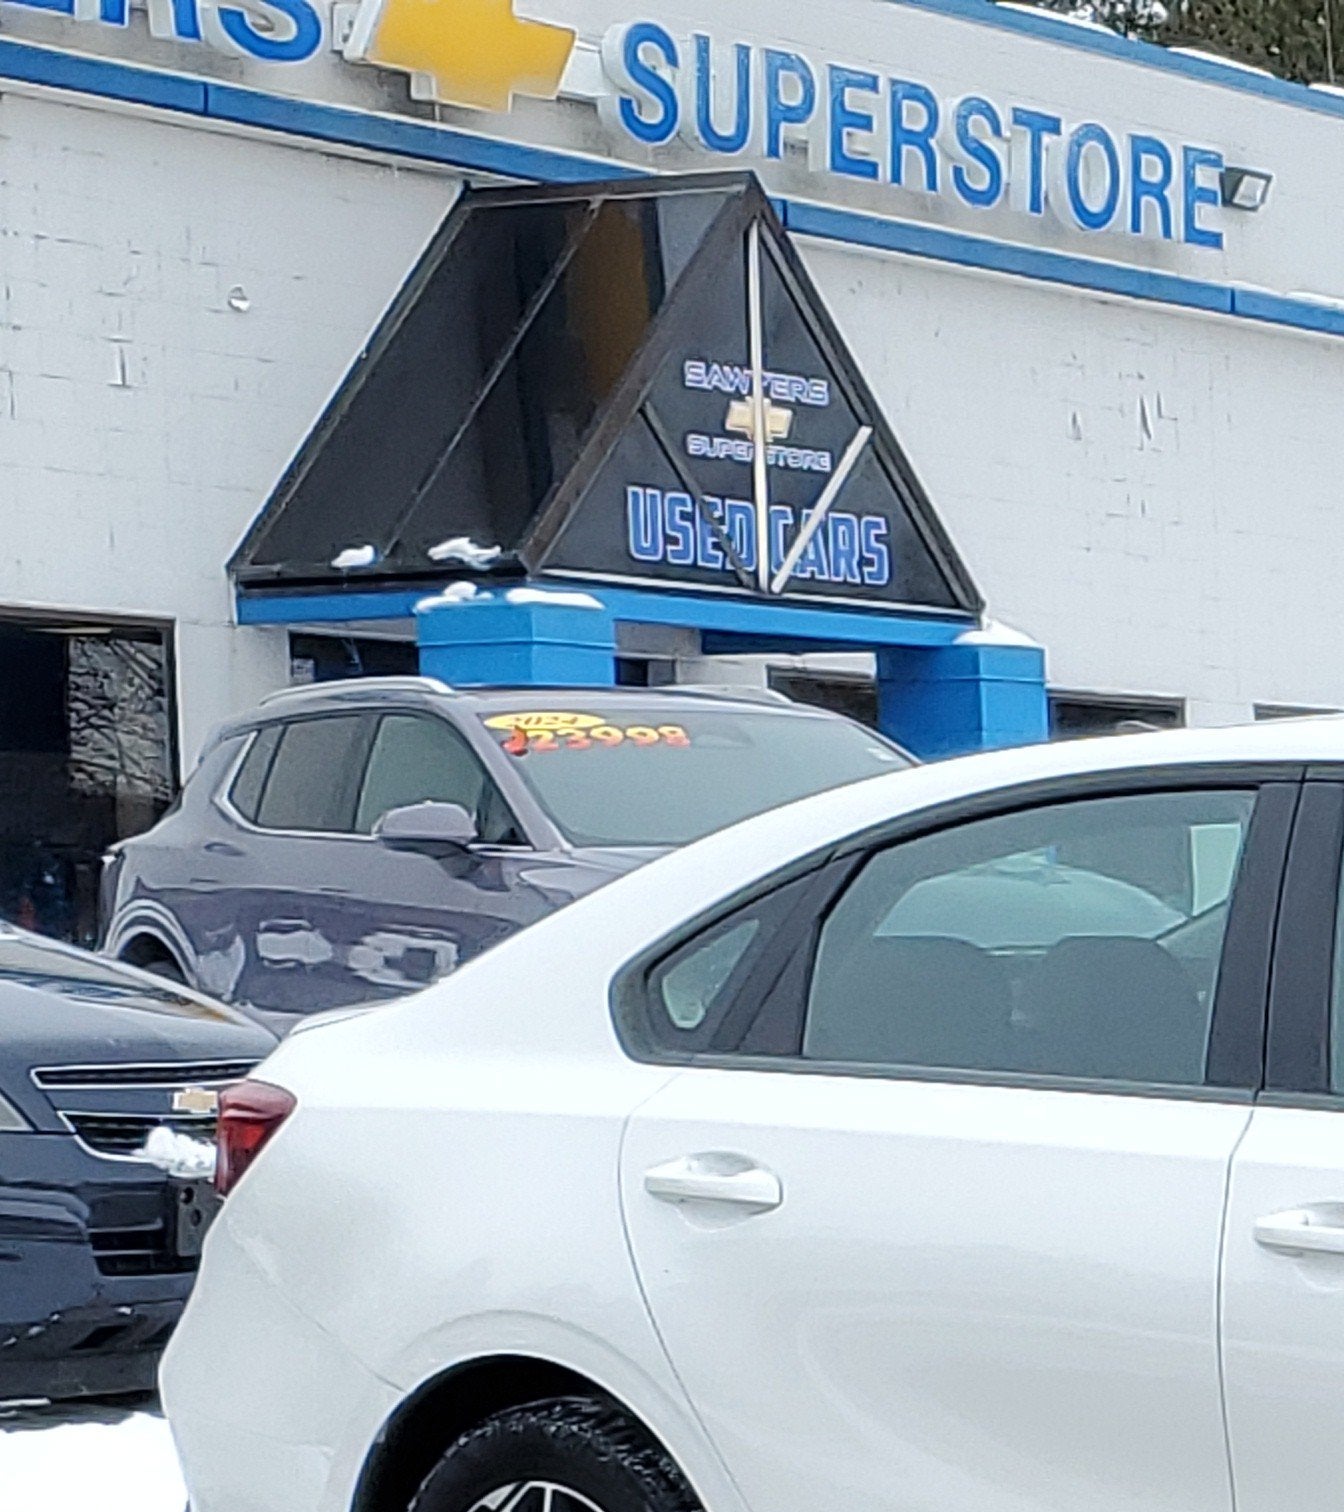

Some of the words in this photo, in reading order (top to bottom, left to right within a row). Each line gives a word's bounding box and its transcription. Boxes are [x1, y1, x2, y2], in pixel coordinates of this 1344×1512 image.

[618, 22, 1224, 249] SUPERSTORE
[627, 485, 757, 571] USED
[769, 505, 889, 585] CARS
